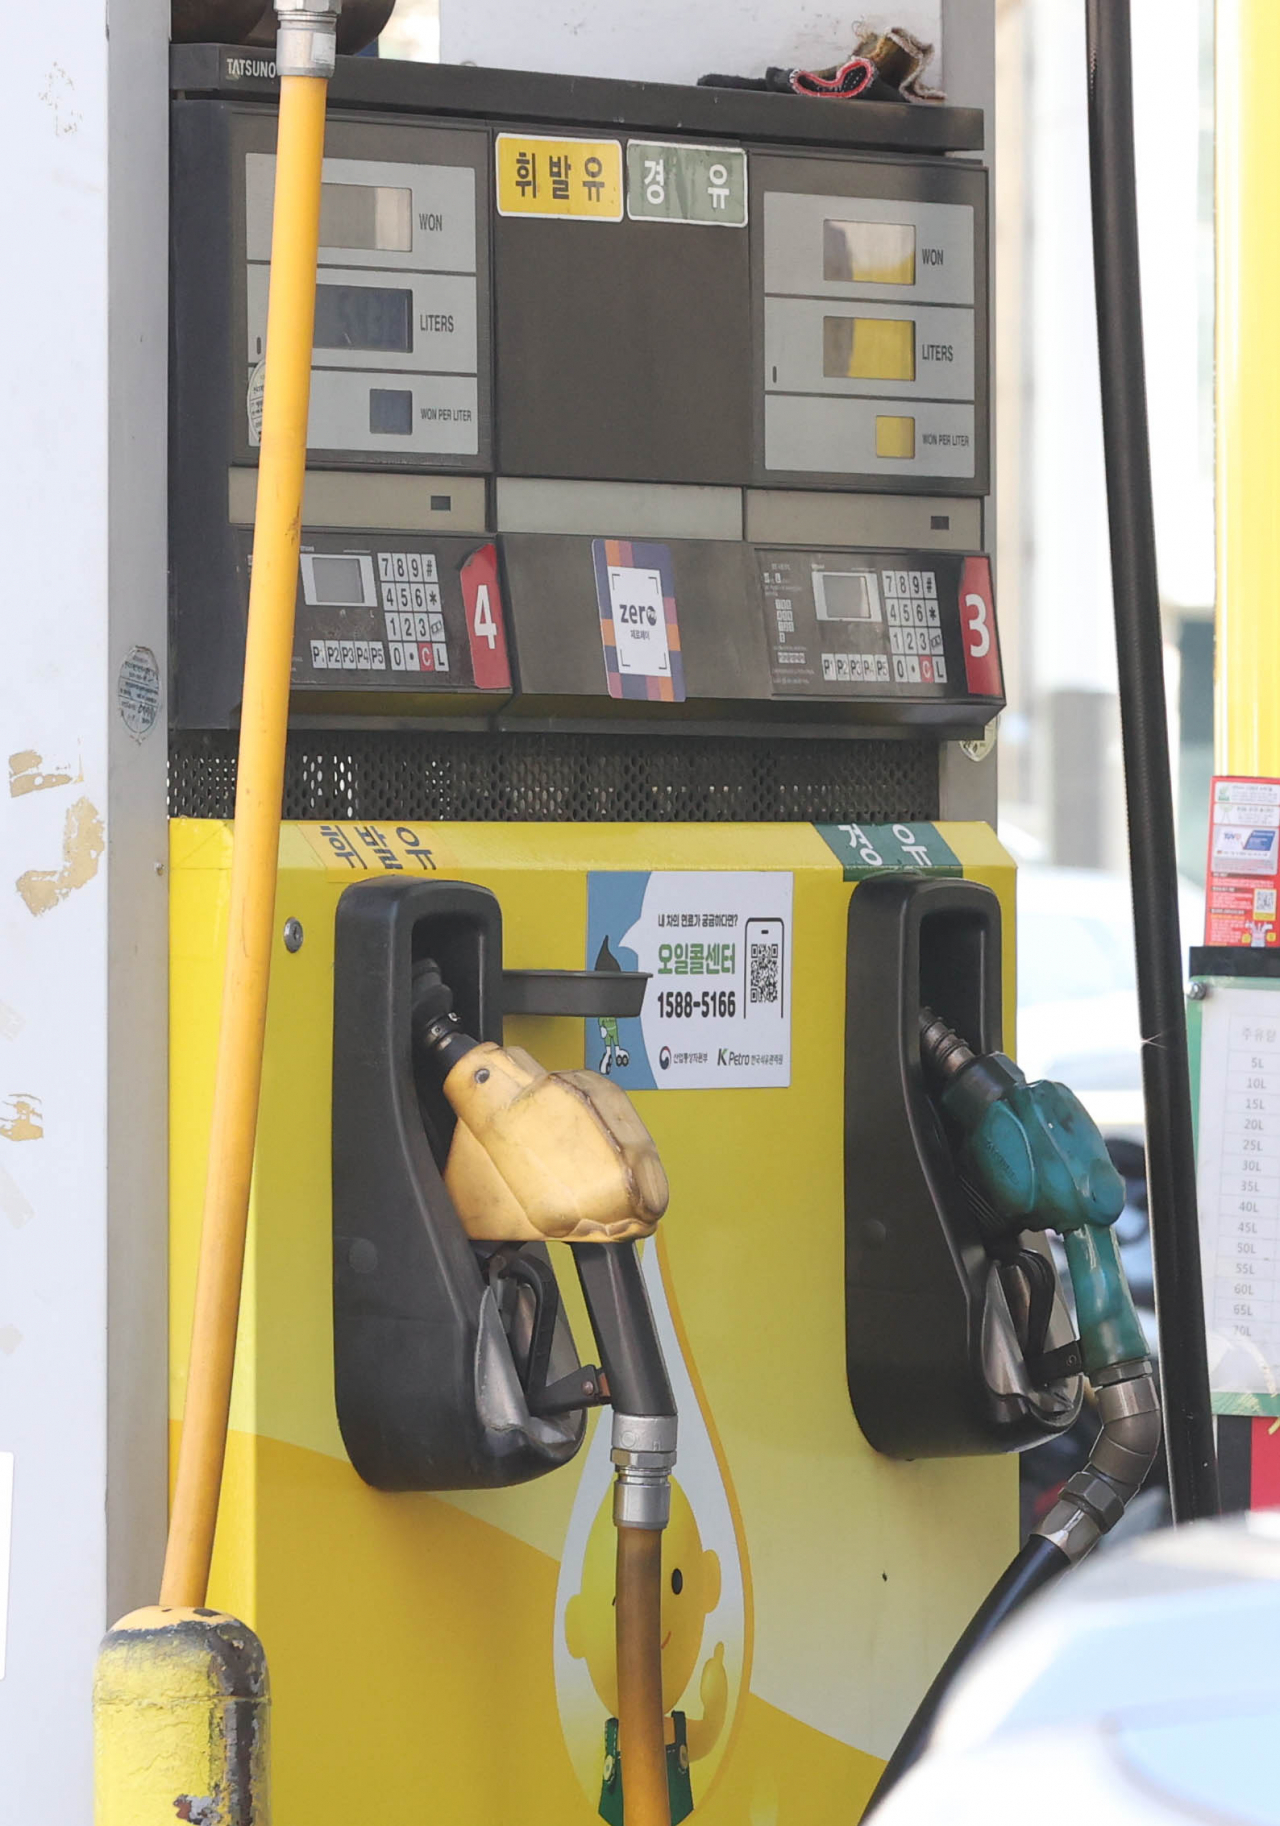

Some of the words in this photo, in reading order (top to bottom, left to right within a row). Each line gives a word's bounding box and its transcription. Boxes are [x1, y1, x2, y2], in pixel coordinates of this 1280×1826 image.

[226, 58, 276, 78] TATSUNO
[515, 151, 605, 203] 휘발유
[419, 213, 443, 231] WON
[922, 248, 944, 266] WON
[420, 314, 454, 333] LITERS
[922, 343, 954, 362] LITERS
[420, 408, 437, 420] WON
[438, 409, 452, 420] PER
[453, 409, 472, 421] LITER
[922, 434, 938, 446] WON
[939, 434, 951, 446] PER
[952, 435, 970, 447] LITER
[474, 584, 497, 650] 4
[965, 593, 990, 658] 3
[327, 646, 340, 663] P2
[341, 646, 355, 663] P3
[371, 647, 384, 664] P5
[320, 825, 437, 870] 휘발유
[658, 914, 665, 927] 내
[666, 914, 680, 928] 차의
[681, 914, 700, 928] 연료가
[702, 914, 738, 928] 궁금하다면?
[657, 943, 736, 975] 오일콜센터
[657, 990, 736, 1018] 1588-5166
[1251, 1057, 1264, 1069] 5L
[1246, 1076, 1267, 1089] 10L
[1245, 1098, 1266, 1110] 15L
[1243, 1118, 1264, 1131] 20L
[1242, 1139, 1263, 1152] 25L
[1241, 1160, 1262, 1172] 30L
[1240, 1180, 1260, 1193] 35L
[1238, 1201, 1259, 1213] 40L
[1238, 1221, 1258, 1234] 45L
[1237, 1242, 1257, 1254] 50L
[1236, 1262, 1255, 1275] 55L
[1234, 1283, 1255, 1296] 60L
[1233, 1303, 1254, 1316] 65L
[1233, 1325, 1252, 1337] 70L
